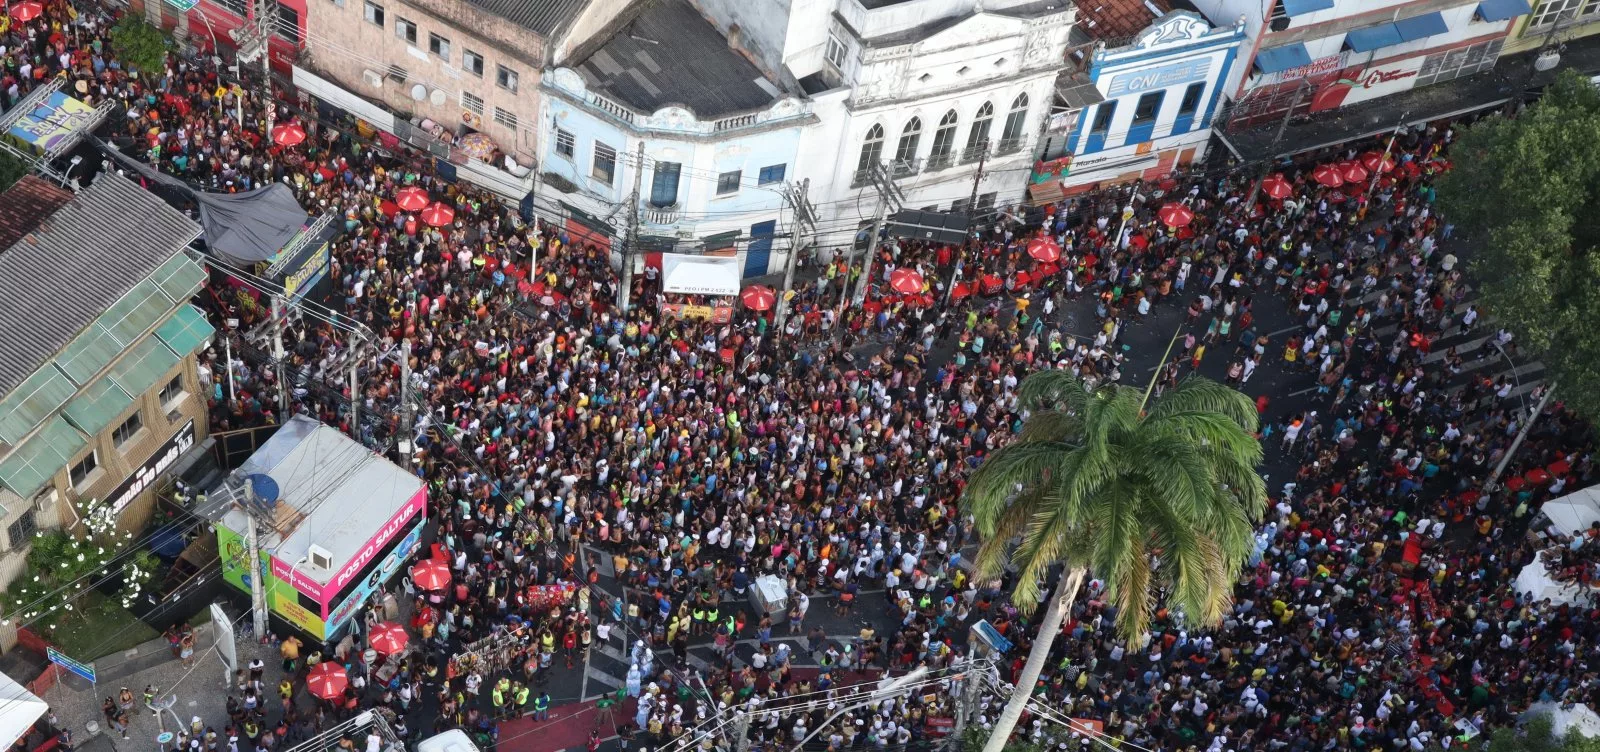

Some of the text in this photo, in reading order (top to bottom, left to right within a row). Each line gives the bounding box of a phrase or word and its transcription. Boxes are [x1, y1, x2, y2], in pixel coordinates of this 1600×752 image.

[1128, 72, 1160, 90] CNI
[142, 468, 156, 486] DO
[155, 445, 178, 474] BRÁS
[338, 504, 414, 587] POSTO SALTUR
[276, 566, 320, 596] POSTO SALTUR
